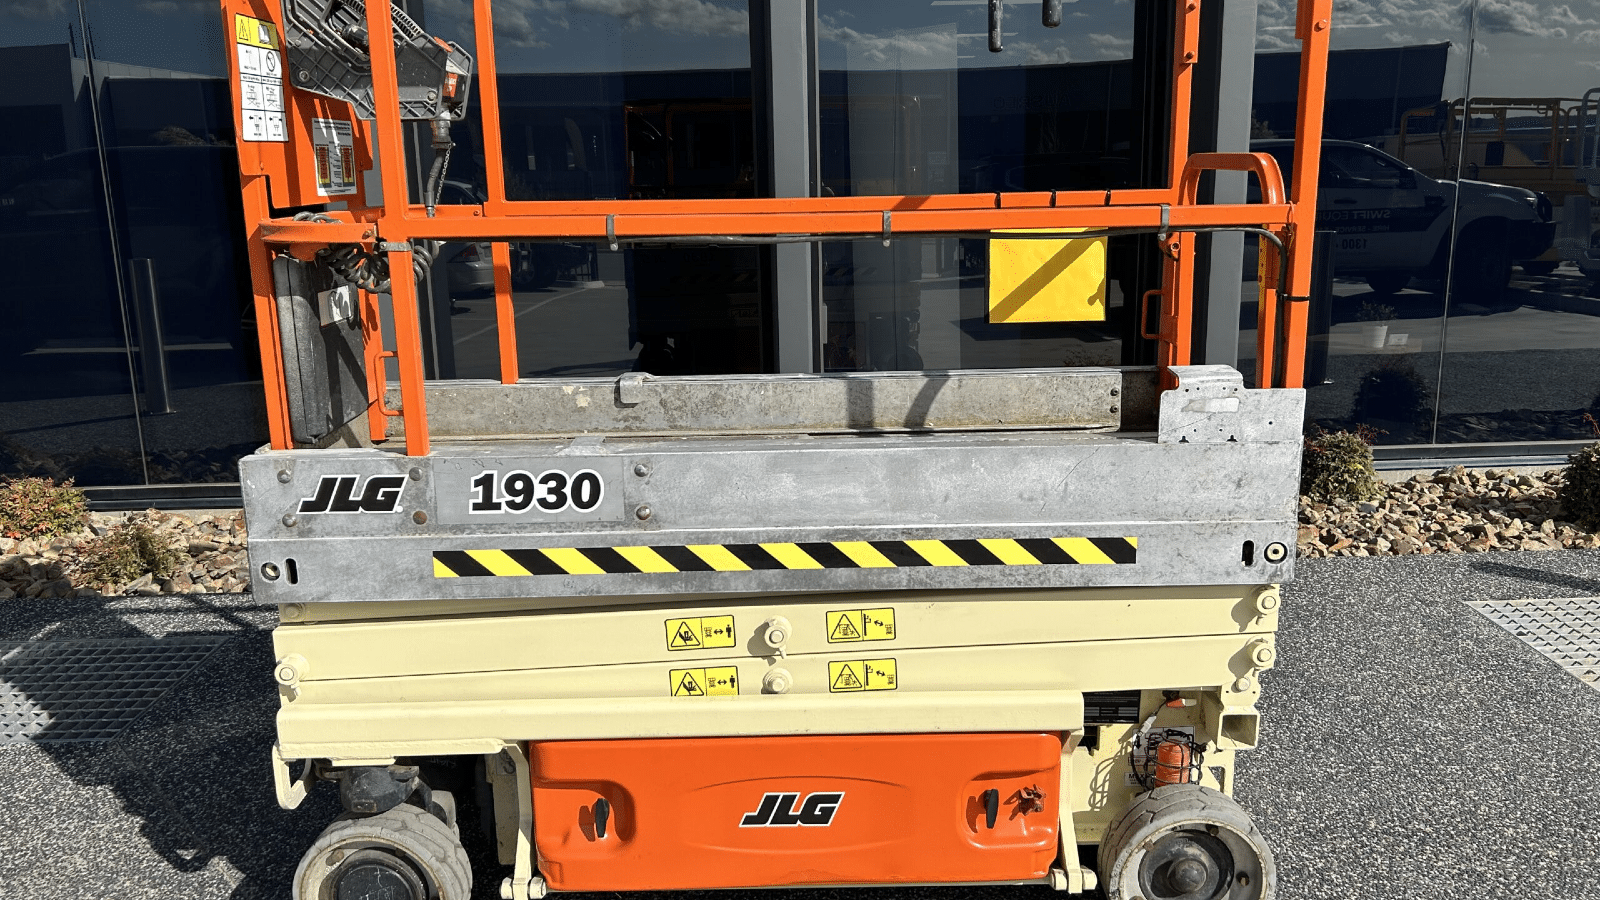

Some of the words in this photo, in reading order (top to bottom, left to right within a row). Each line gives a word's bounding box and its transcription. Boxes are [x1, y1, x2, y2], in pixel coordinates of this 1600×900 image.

[296, 474, 406, 515] JLG
[469, 468, 604, 515] 1930
[738, 791, 846, 828] JLG
